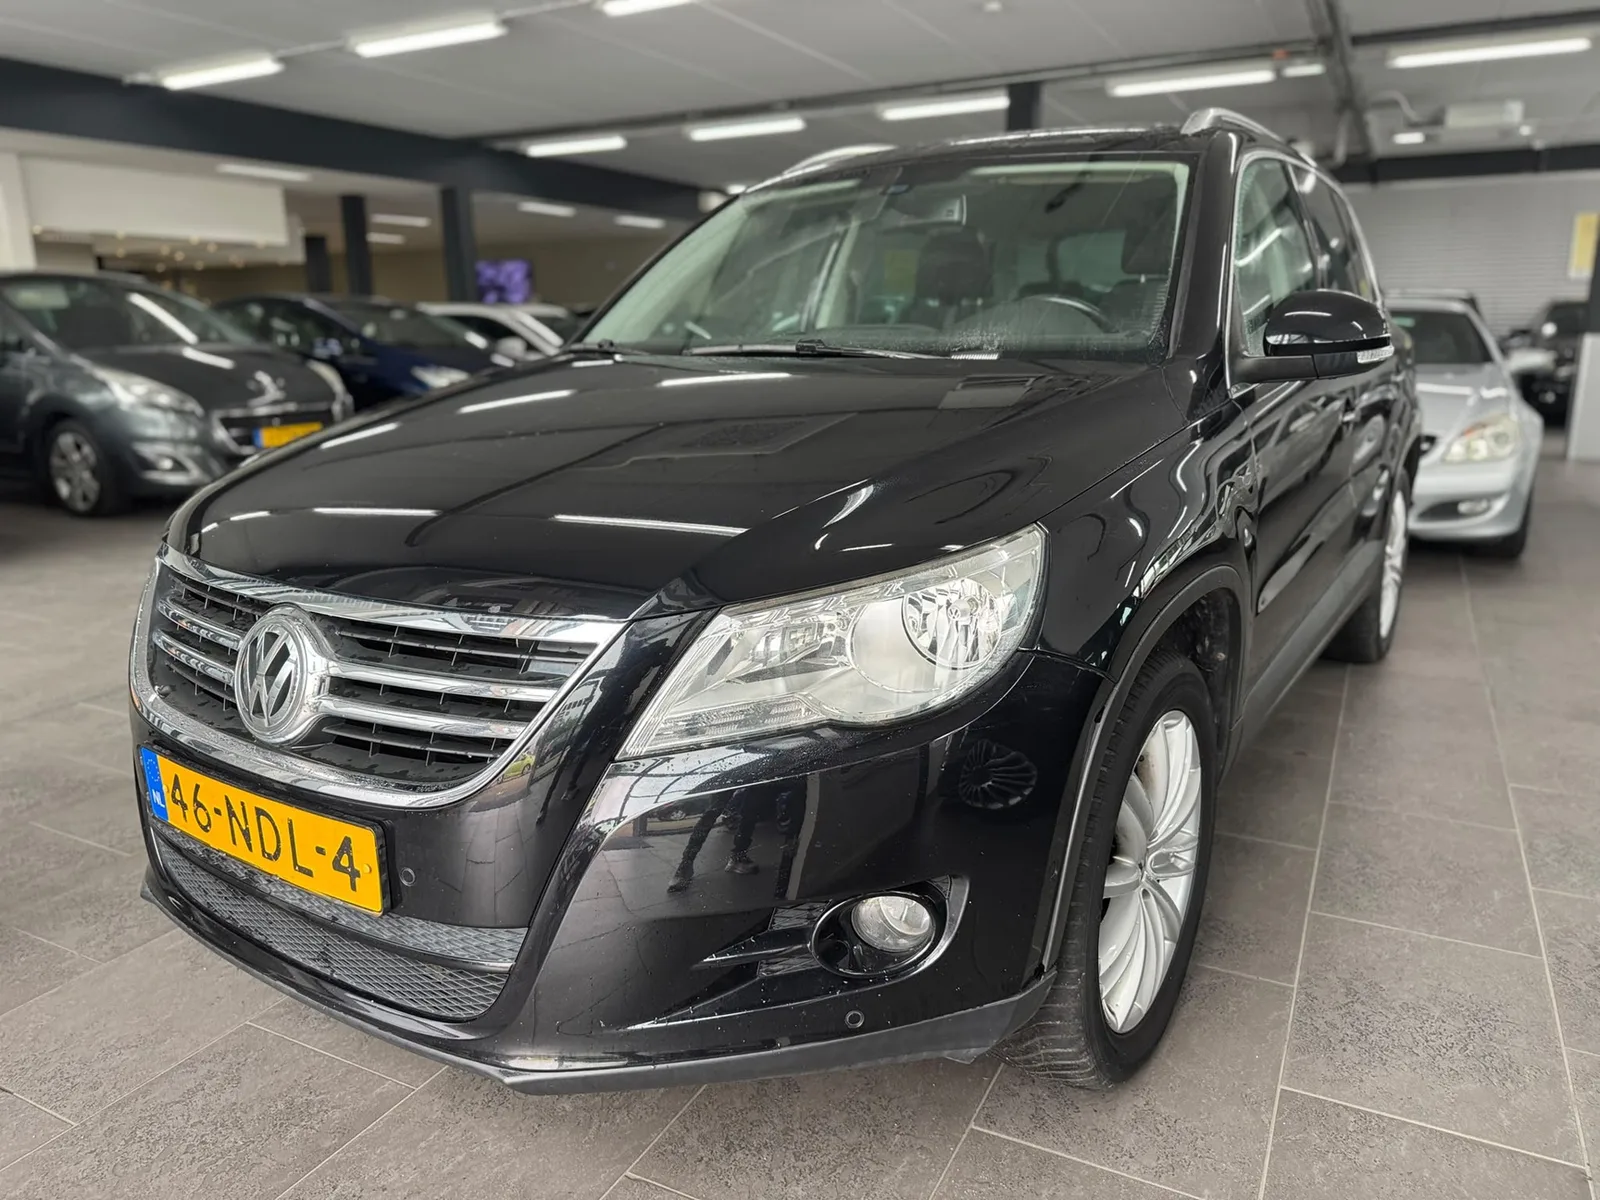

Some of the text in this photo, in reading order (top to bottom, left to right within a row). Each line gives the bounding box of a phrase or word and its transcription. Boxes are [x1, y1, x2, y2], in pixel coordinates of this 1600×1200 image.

[240, 621, 299, 728] VW
[151, 788, 166, 809] NL
[170, 773, 361, 892] 46-NDL-4
